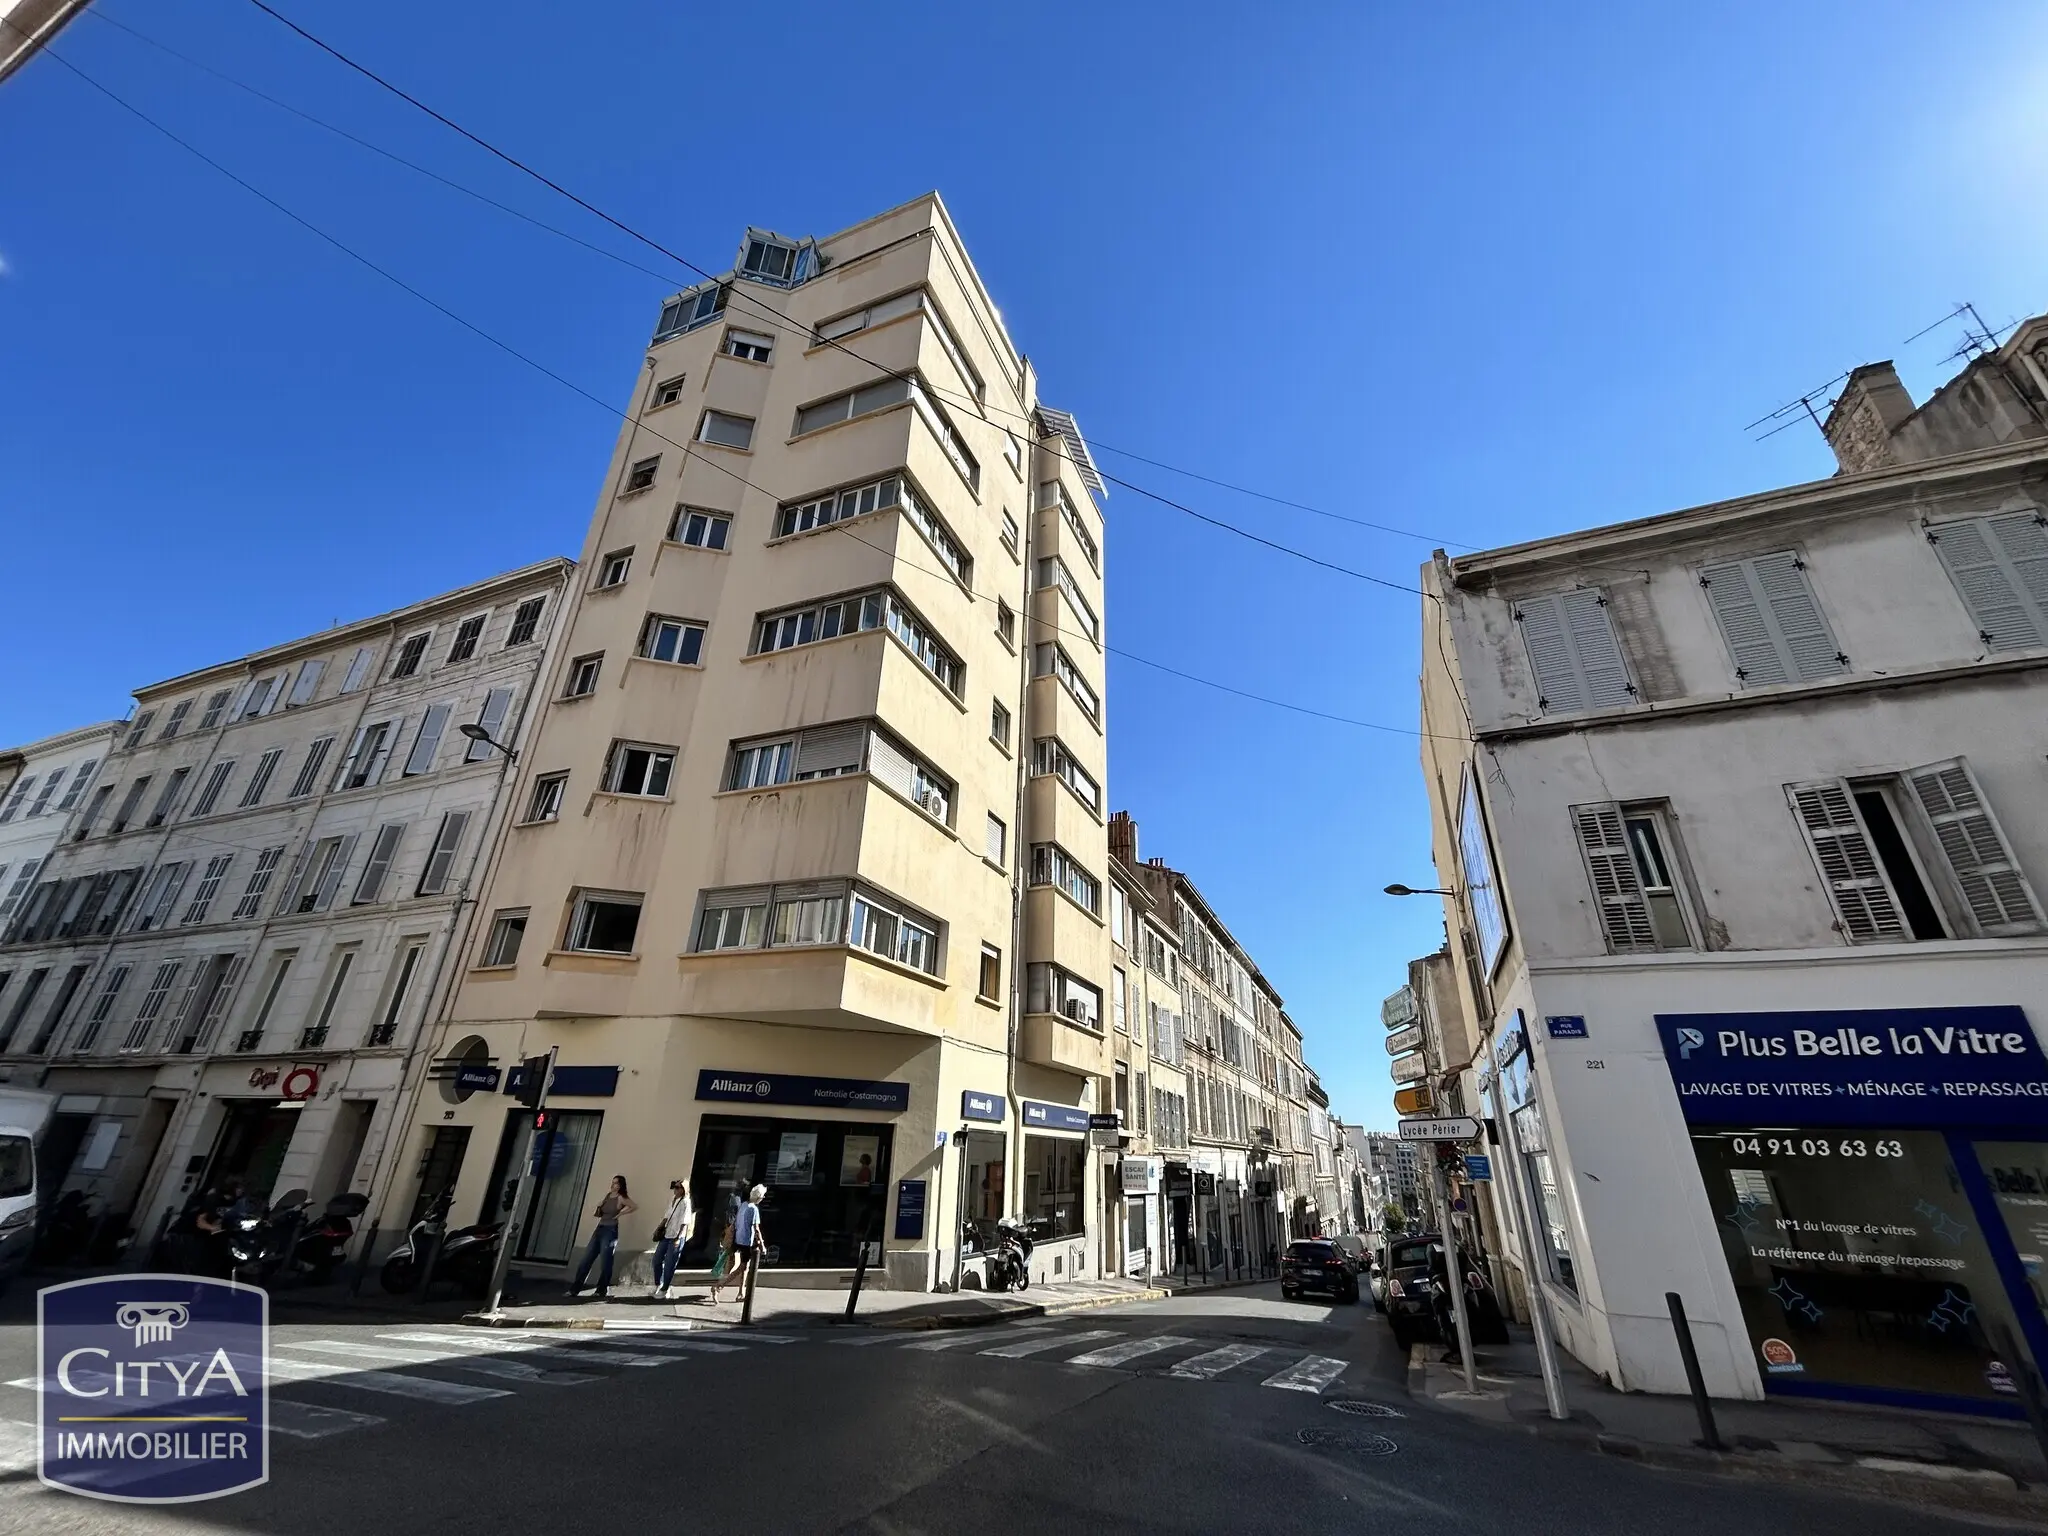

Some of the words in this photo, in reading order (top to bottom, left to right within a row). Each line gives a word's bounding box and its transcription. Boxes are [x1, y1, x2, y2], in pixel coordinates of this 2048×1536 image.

[1717, 1030, 1787, 1057] Plus
[1793, 1028, 1883, 1056] Belle
[1586, 1060, 1605, 1069] 221
[462, 1073, 487, 1083] Allianz
[710, 1079, 753, 1093] Allianz
[1681, 1082, 1743, 1095] LAVAGE
[1747, 1082, 1770, 1095] DE
[1772, 1082, 1833, 1096] VITRES
[1848, 1080, 1927, 1096] MÉNAGE
[814, 1088, 848, 1099] Nathalie
[848, 1090, 897, 1103] Costamagna
[969, 1098, 986, 1110] Allianz
[1403, 1125, 1428, 1137] Lycée
[1733, 1138, 1761, 1157] 04
[1767, 1139, 1796, 1156] 91
[1801, 1139, 1831, 1156] 03
[1839, 1140, 1868, 1157] 63
[1875, 1140, 1904, 1158] 63
[1803, 1220, 1818, 1231] du
[1821, 1221, 1860, 1235] lavage
[1863, 1224, 1879, 1234] de
[1881, 1224, 1917, 1236] vitres
[1752, 1246, 1766, 1257] La
[1768, 1246, 1825, 1260] référence
[1828, 1251, 1843, 1262] du
[1847, 1253, 1967, 1271] ménage/repassage
